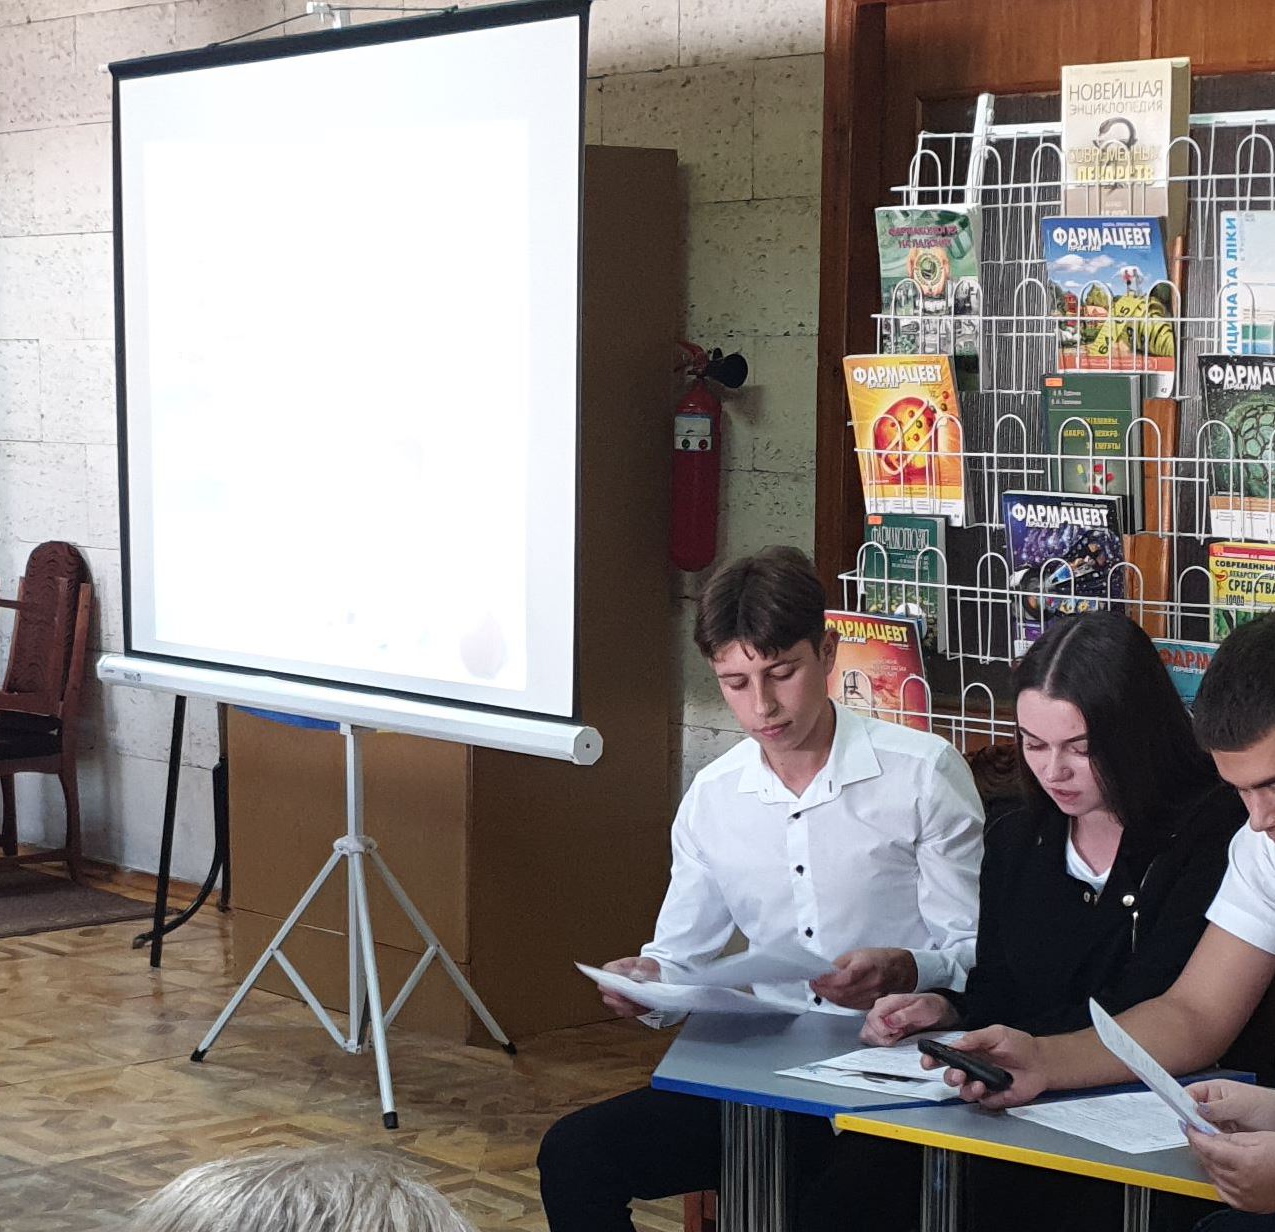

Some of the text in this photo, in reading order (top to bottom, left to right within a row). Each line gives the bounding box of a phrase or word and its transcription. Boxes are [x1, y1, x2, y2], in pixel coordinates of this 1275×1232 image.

[1069, 78, 1163, 101] НОВЕЙШАЯ
[1070, 100, 1163, 116] ЭНЦИКЛОПЕДИЯ
[1052, 227, 1151, 250] ФАРМАЦЕВТ
[1225, 217, 1238, 261] ЛІКИ
[853, 365, 942, 386] ФАРМАЦЕВТ
[1012, 503, 1109, 528] ФАРМАЦЕВТ
[825, 619, 908, 643] ФАРМАЦЕВТ
